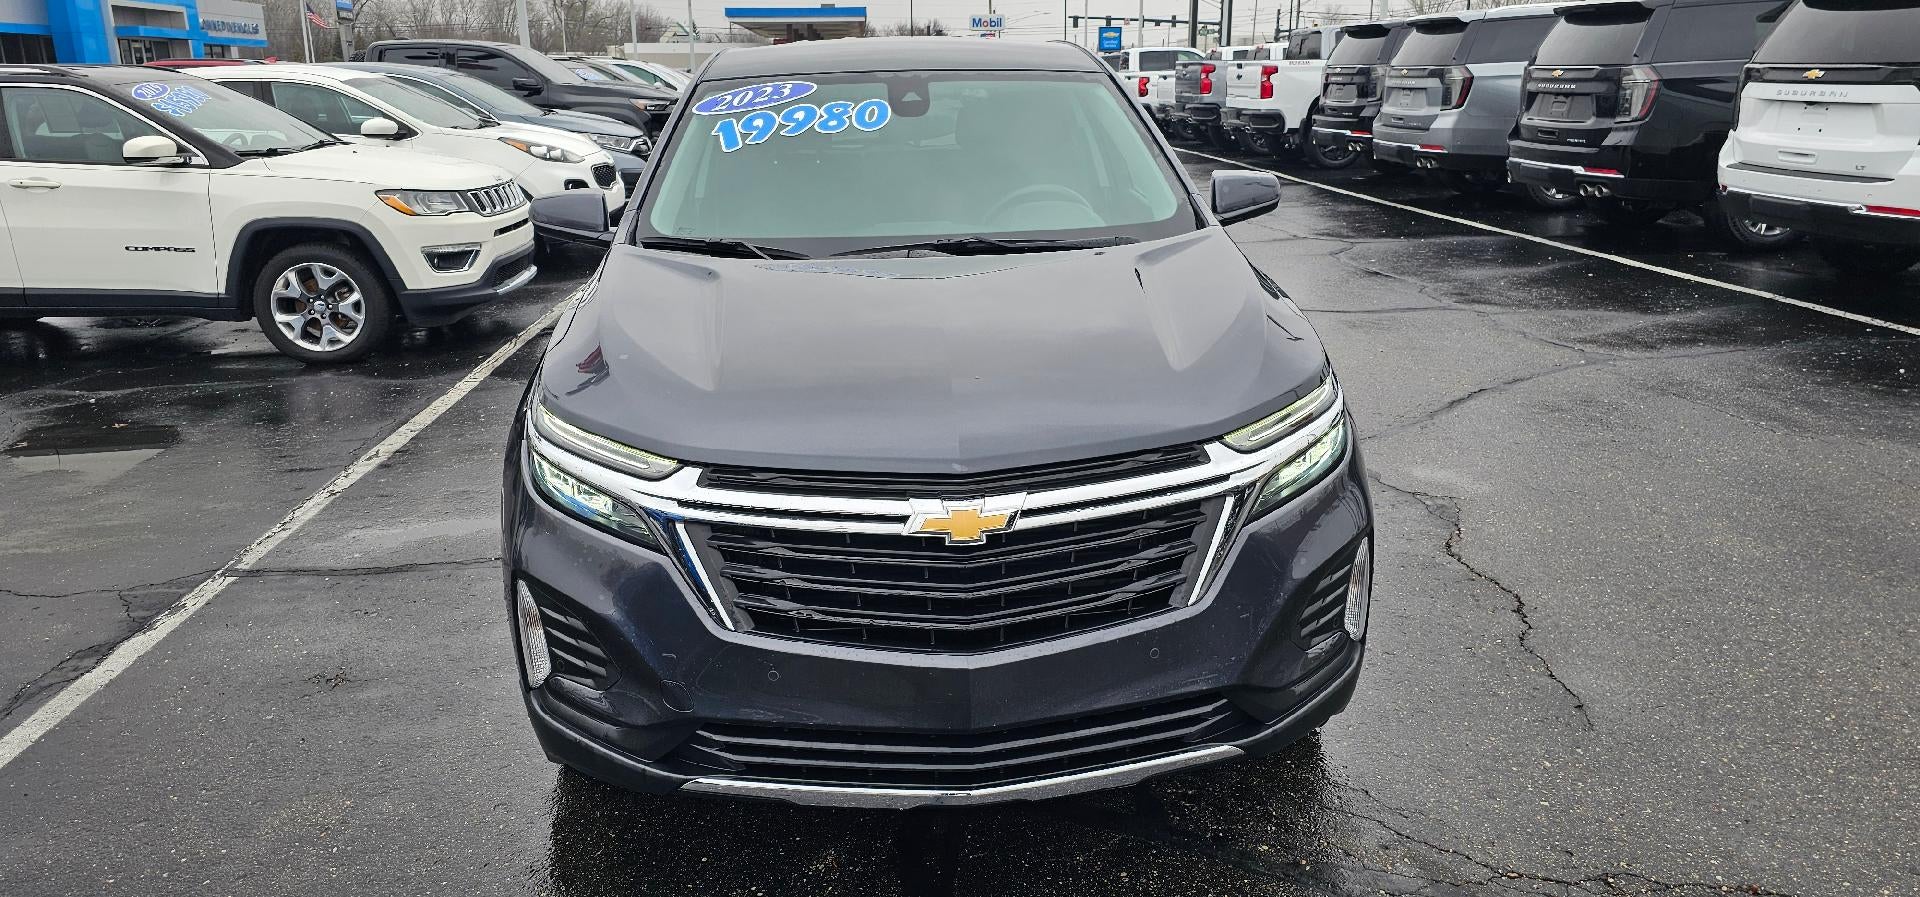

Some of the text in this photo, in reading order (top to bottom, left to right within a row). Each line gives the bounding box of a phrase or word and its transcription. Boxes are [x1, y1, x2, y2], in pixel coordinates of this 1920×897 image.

[972, 17, 1002, 28] Mobil
[709, 83, 794, 113] 2023
[1776, 89, 1848, 98] SUBURBAN
[712, 99, 892, 153] 19980
